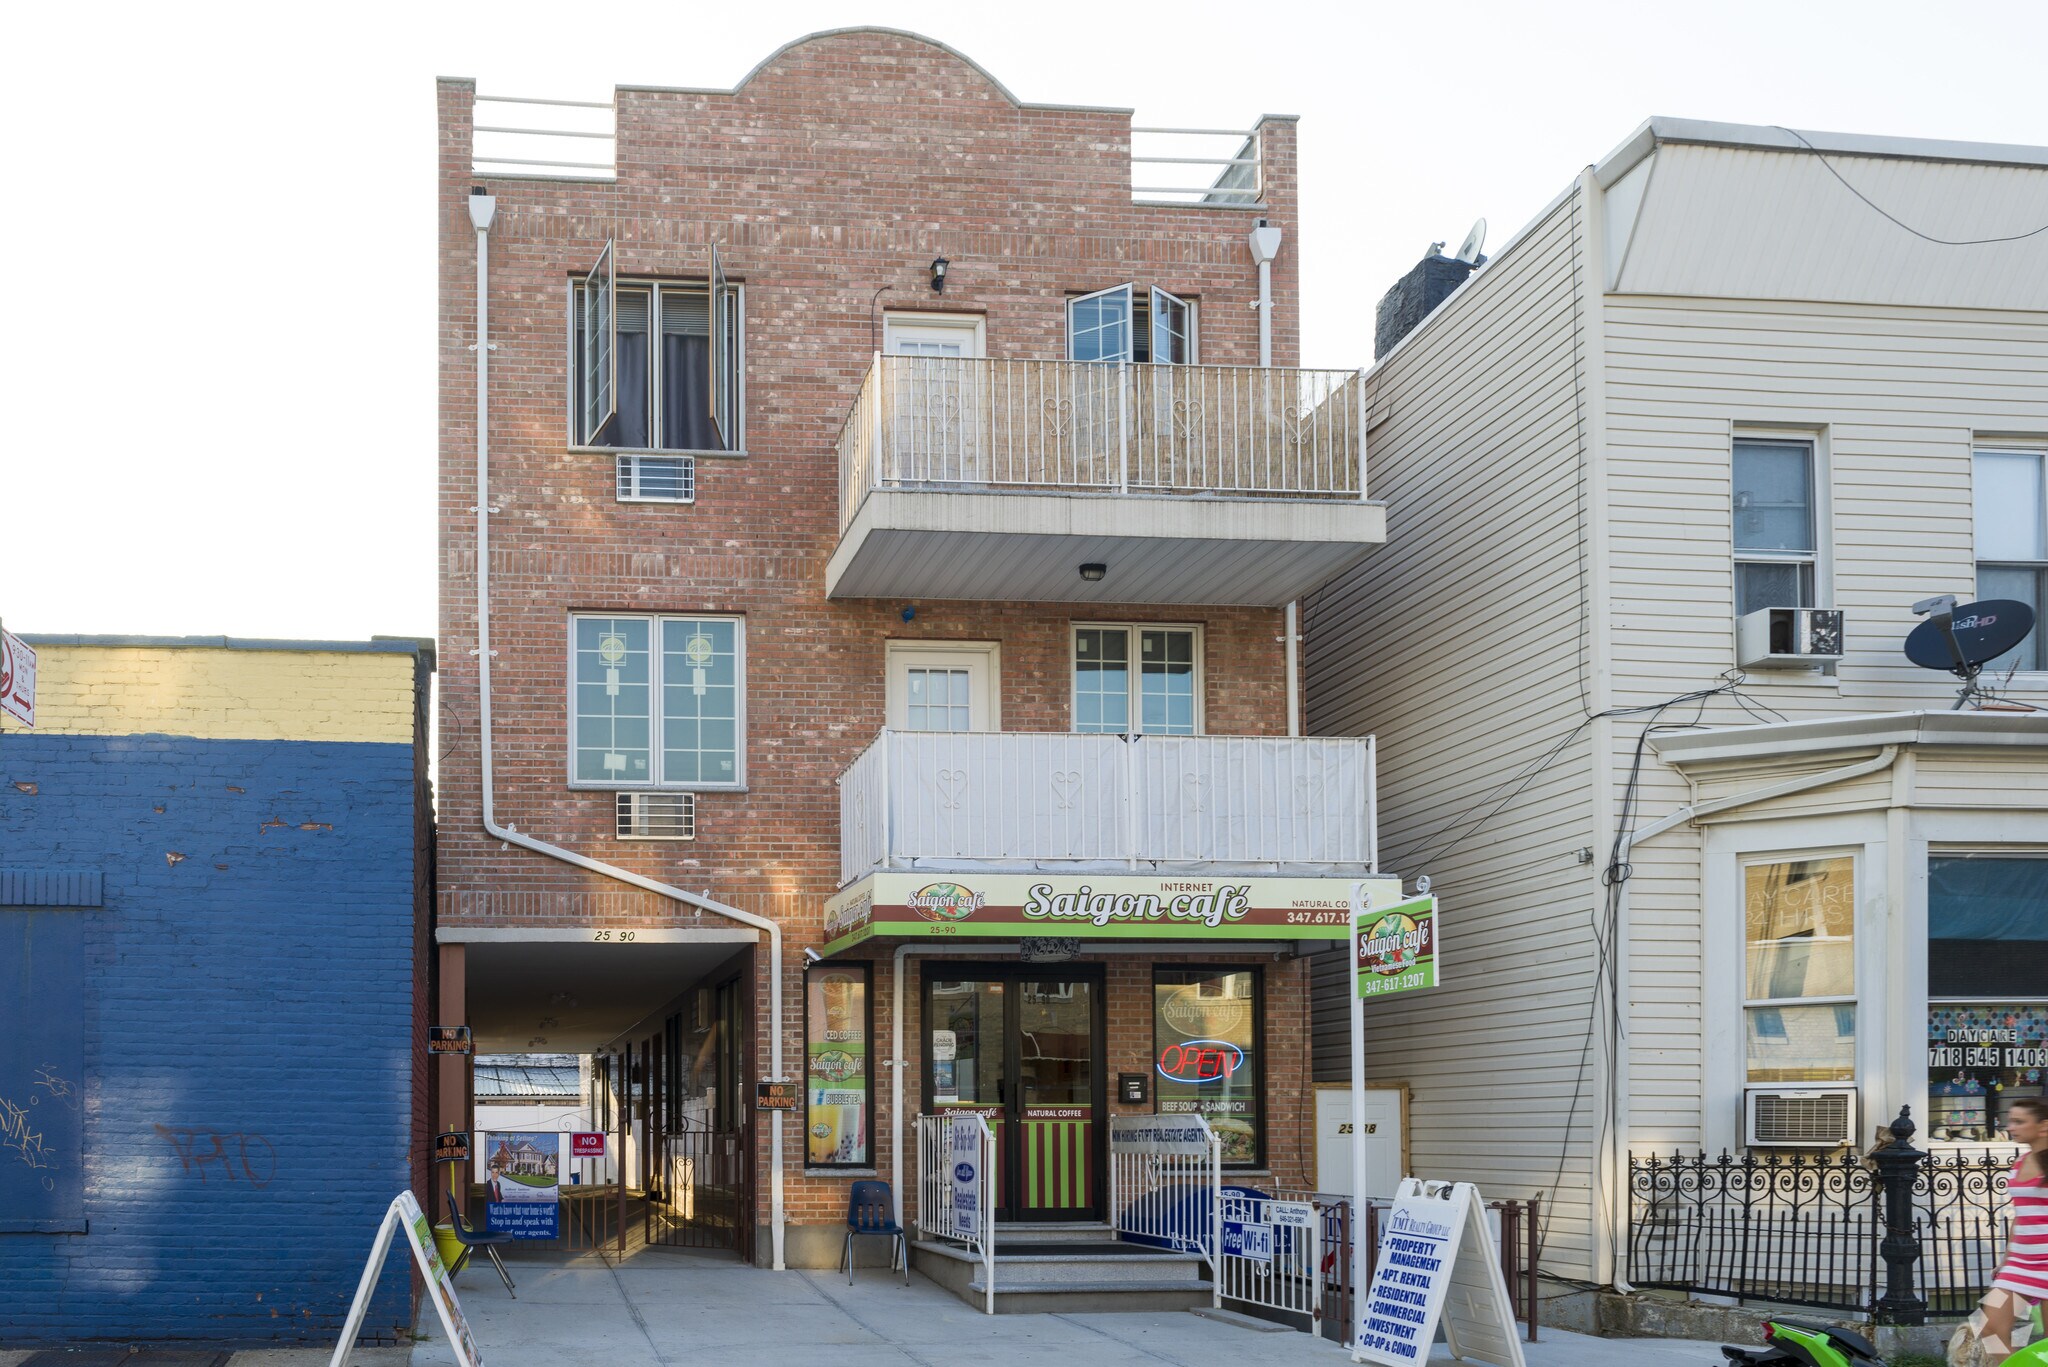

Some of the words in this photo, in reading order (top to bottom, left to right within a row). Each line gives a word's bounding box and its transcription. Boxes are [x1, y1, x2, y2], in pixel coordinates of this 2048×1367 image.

[1160, 882, 1213, 892] INTERNET
[957, 891, 986, 912] café
[1748, 890, 1777, 910] AY
[1785, 884, 1854, 907] CARE
[1023, 883, 1168, 928] Saigon
[1168, 884, 1252, 928] café
[1292, 900, 1333, 908] NATURAL
[1287, 911, 1351, 924] 347.617.12
[1780, 904, 1845, 927] HRS
[594, 930, 611, 941] 25
[619, 931, 635, 942] 90
[930, 926, 956, 934] 25-90
[1403, 919, 1430, 954] café
[1371, 960, 1402, 973] Vietnamese
[1402, 957, 1417, 968] Food
[1365, 972, 1425, 994] 347-617-1207
[1167, 1001, 1210, 1023] Saigon
[442, 1029, 456, 1039] NO
[823, 1030, 838, 1040] ICED
[839, 1030, 862, 1040] COFFEE
[1949, 1029, 2017, 1042] DAYCARE
[430, 1040, 468, 1050] PARKING
[1160, 1045, 1237, 1079] OPEN
[1930, 1048, 1961, 1066] 718
[1967, 1048, 1998, 1066] 545
[2007, 1048, 2048, 1067] 1403
[843, 1057, 863, 1074] café
[769, 1085, 784, 1096] NO
[758, 1096, 795, 1107] PARKING
[826, 1093, 848, 1105] BUBBLE
[848, 1093, 861, 1105] TEA
[977, 1107, 997, 1117] café
[1027, 1109, 1056, 1117] NATURAL
[1057, 1109, 1082, 1117] COFFEE
[1162, 1101, 1178, 1111] BEEF
[1178, 1101, 1198, 1111] SOUP
[1206, 1101, 1246, 1112] SANDWICH
[443, 1135, 457, 1147] NO
[581, 1136, 597, 1146] NO
[1153, 1128, 1164, 1142] REAL
[1165, 1128, 1183, 1142] ESTATE
[1183, 1127, 1205, 1142] AGENTS
[436, 1146, 467, 1158] PARKING
[1276, 1206, 1289, 1214] CALL:
[1290, 1207, 1309, 1217] Anthony
[491, 1217, 504, 1227] Stop
[505, 1217, 511, 1226] in
[512, 1217, 523, 1226] and
[523, 1217, 540, 1228] speak
[540, 1217, 554, 1226] with
[1393, 1217, 1409, 1230] TMT
[528, 1229, 552, 1237] agents.
[1224, 1227, 1242, 1249] Free
[1243, 1230, 1268, 1253] Wi-fi
[1389, 1238, 1436, 1256] PROPERTY
[1389, 1252, 1441, 1272] MANAGEMENT
[1381, 1268, 1398, 1283] APT.
[1399, 1272, 1431, 1289] RENTAL
[1376, 1285, 1427, 1307] RESIDENTIAL
[1372, 1301, 1426, 1325] COMMERCIAL
[1367, 1317, 1417, 1340] INVESTMENT
[1363, 1333, 1385, 1350] CO-OP
[1384, 1341, 1390, 1351] &
[1391, 1340, 1418, 1359] CONDO
